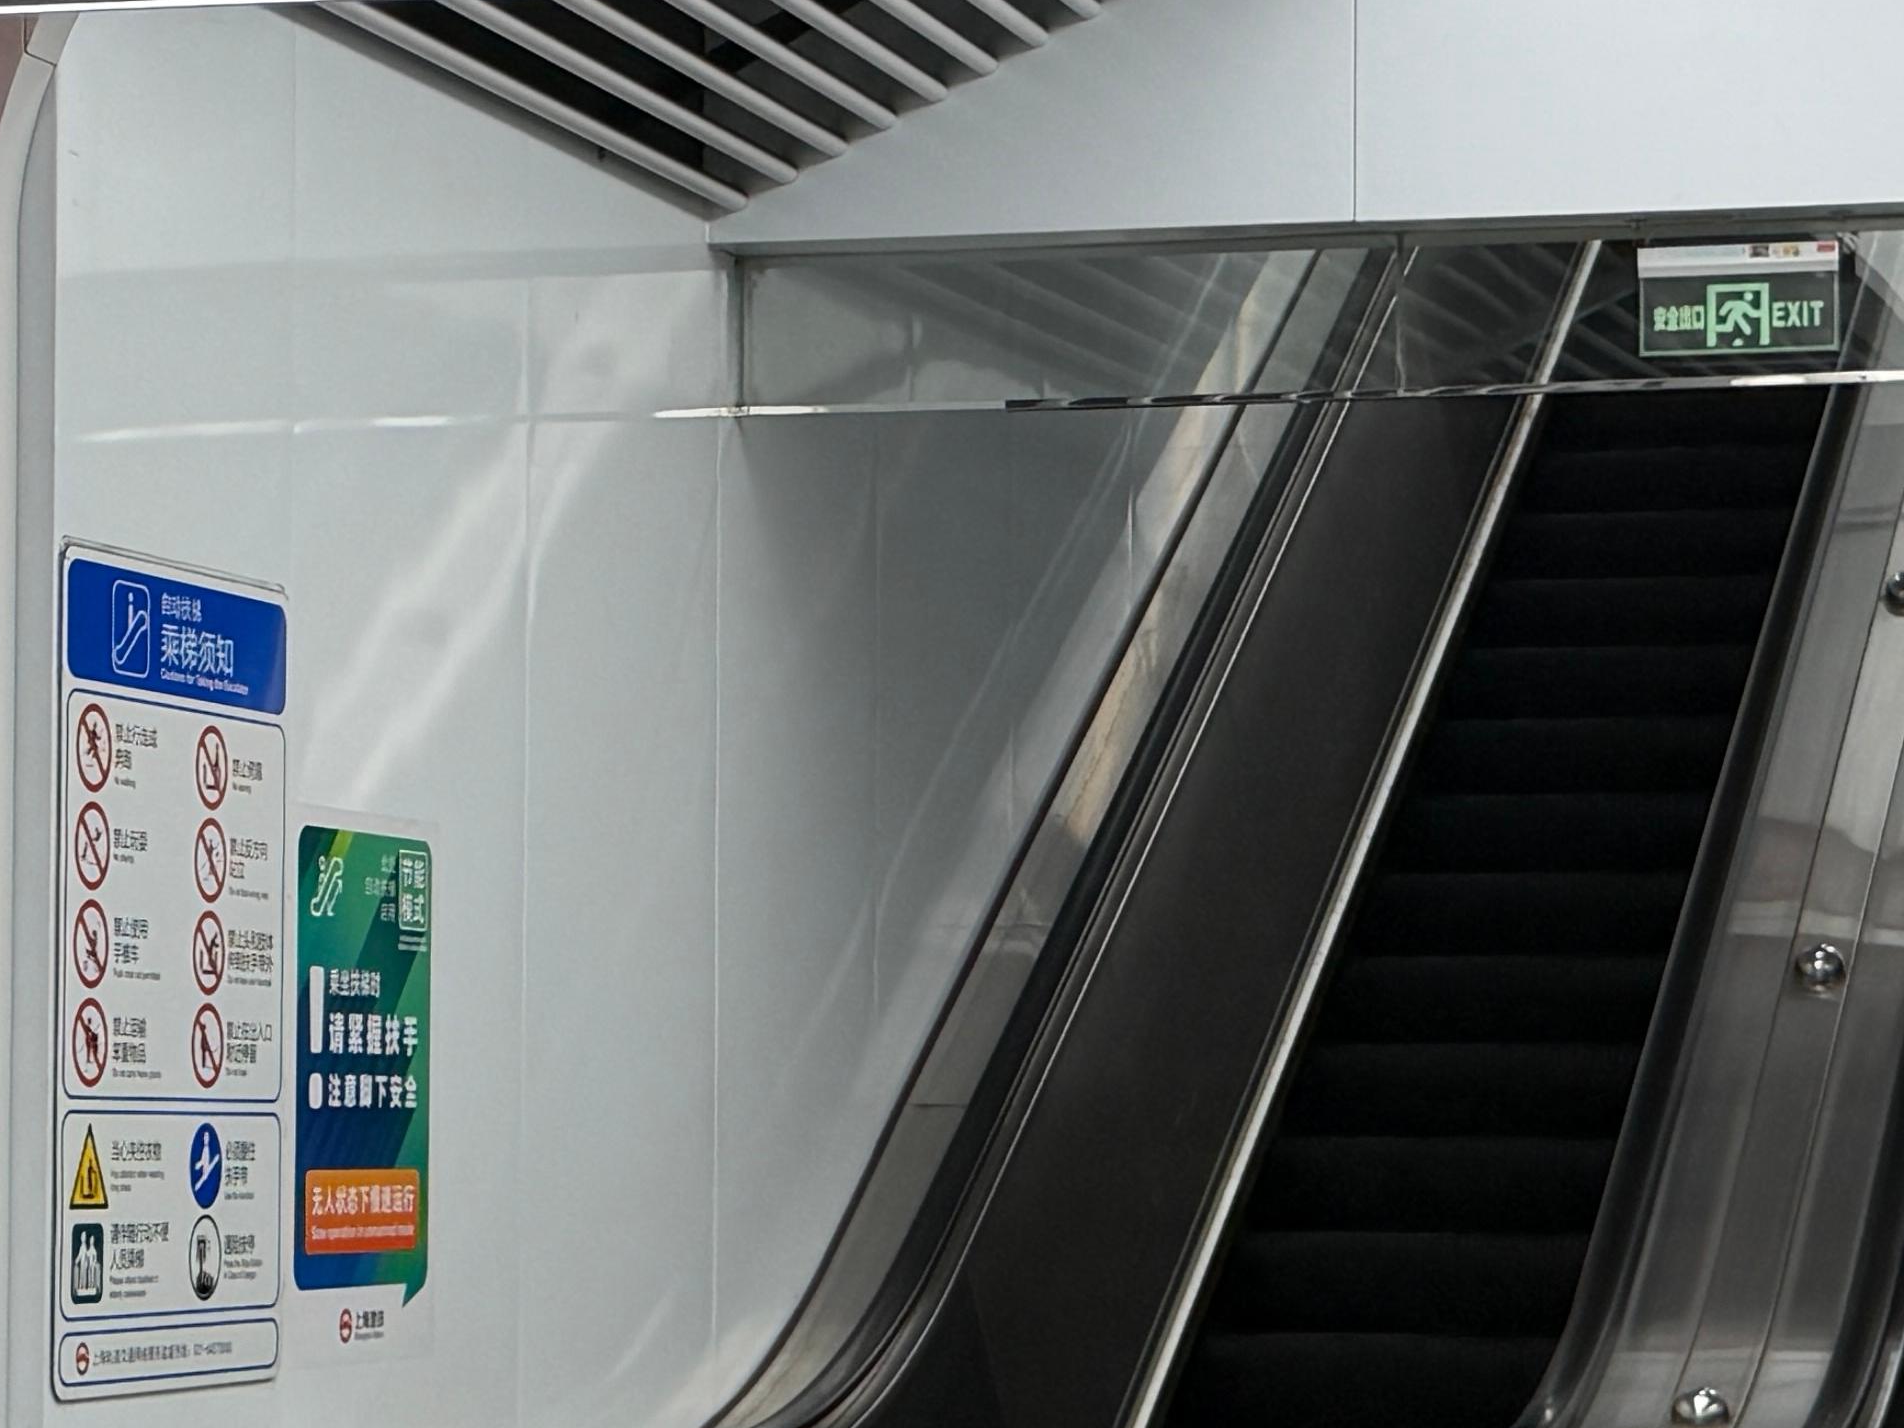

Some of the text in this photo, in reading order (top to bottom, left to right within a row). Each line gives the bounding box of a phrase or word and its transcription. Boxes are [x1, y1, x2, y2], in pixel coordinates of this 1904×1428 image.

[1653, 304, 1705, 332] 安全出口
[1771, 299, 1825, 328] EXIT
[161, 592, 203, 623] 自动扶梯
[160, 623, 234, 678] 乘梯须知
[328, 1011, 418, 1058] 请紧握扶手
[327, 1072, 418, 1109] 注意脚下安全
